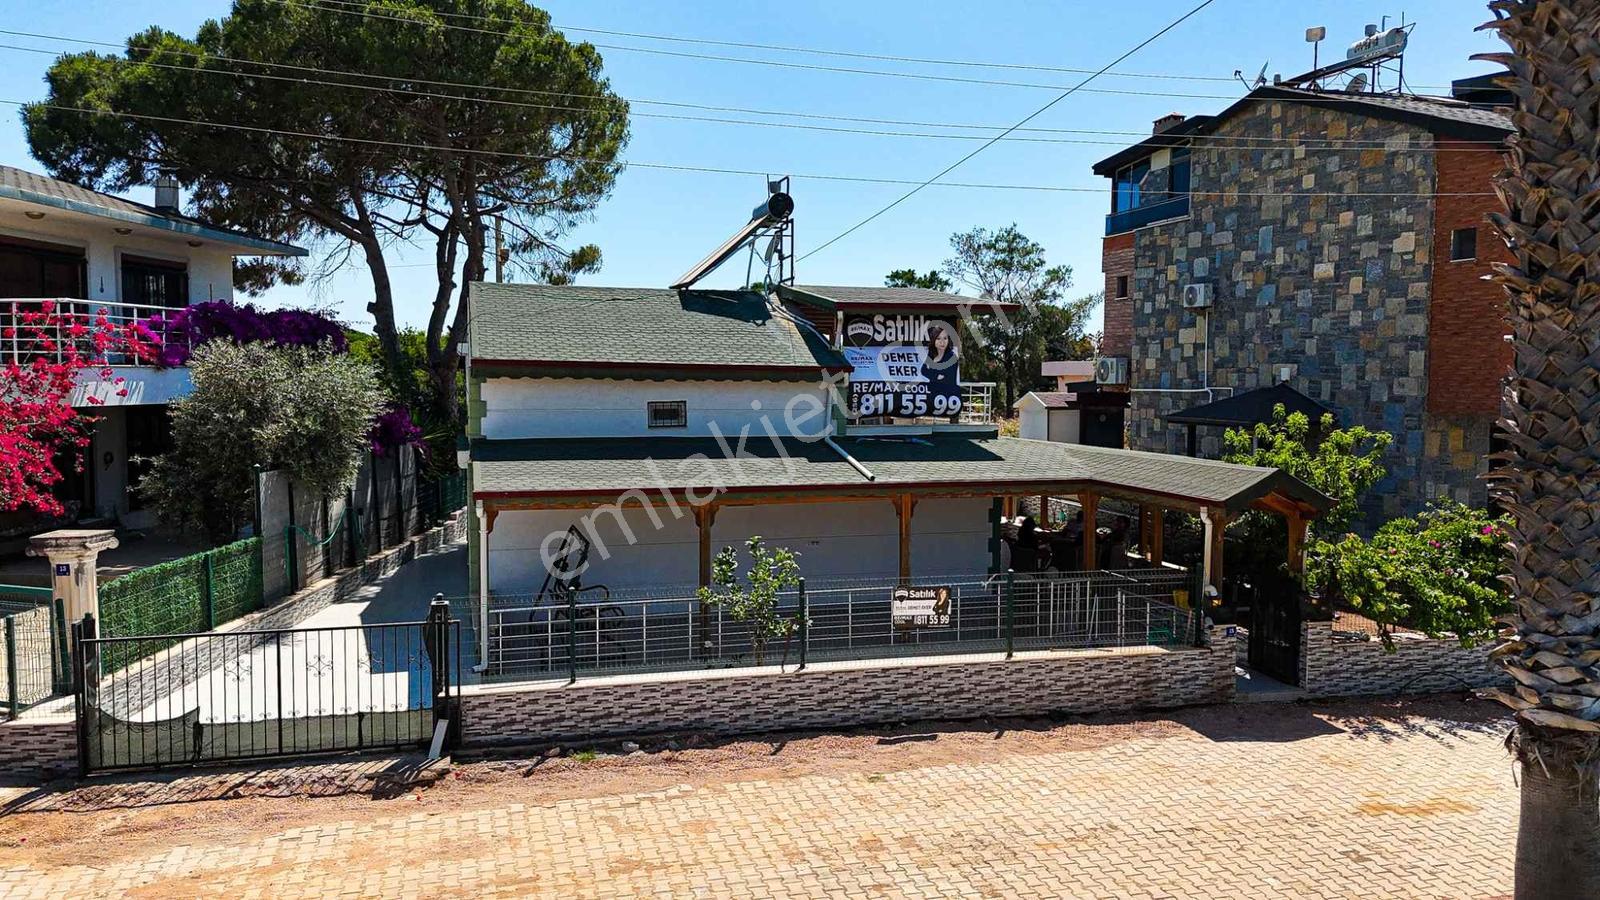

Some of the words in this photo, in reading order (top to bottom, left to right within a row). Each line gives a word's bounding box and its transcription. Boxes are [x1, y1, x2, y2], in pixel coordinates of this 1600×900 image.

[873, 314, 932, 342] Satılık
[882, 352, 919, 364] DEMET
[889, 366, 919, 377] EKER
[853, 382, 900, 393] RE/MAX
[904, 384, 931, 394] COOL
[860, 393, 894, 416] 811
[900, 394, 928, 416] 55
[933, 395, 962, 416] 99
[909, 589, 936, 598] Satılık
[929, 615, 938, 625] 55
[940, 615, 950, 625] 99
